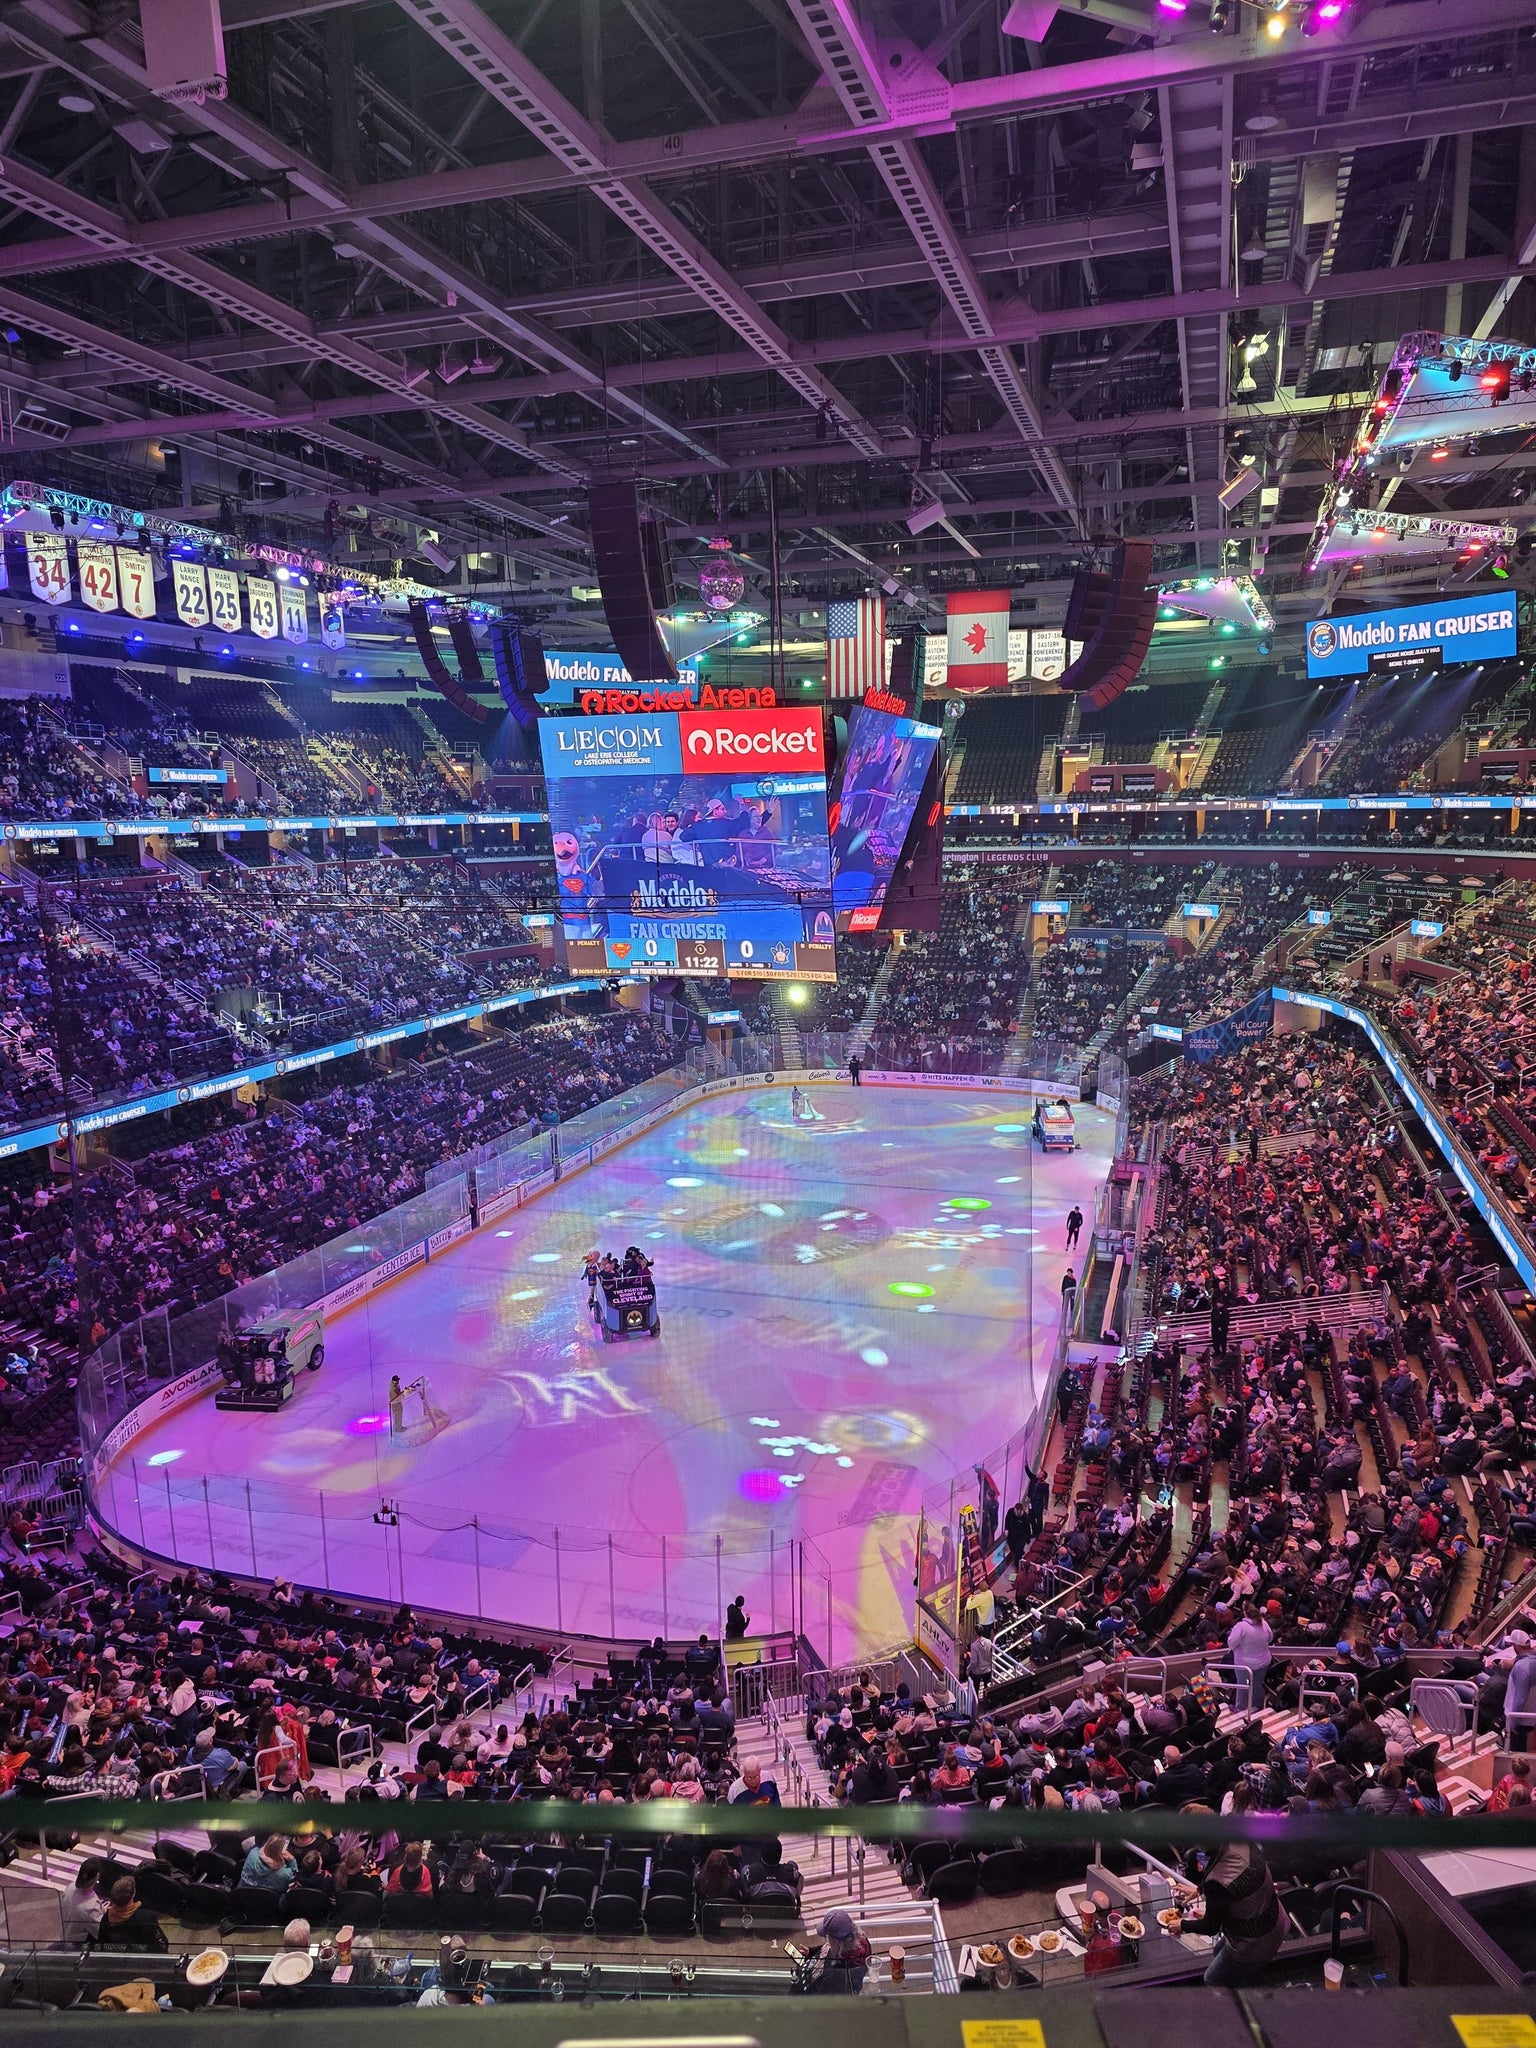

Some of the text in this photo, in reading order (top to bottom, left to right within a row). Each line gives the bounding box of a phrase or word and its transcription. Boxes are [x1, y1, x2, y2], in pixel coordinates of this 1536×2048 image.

[34, 555, 66, 590] 34
[125, 562, 146, 572] SMITH
[179, 566, 199, 577] LARRY
[85, 565, 113, 599] 42
[180, 574, 200, 584] NANCE
[214, 572, 231, 582] MARK
[130, 573, 142, 603] 7
[215, 580, 232, 590] PRICE
[254, 581, 269, 590] BRAD
[179, 584, 205, 615] 22
[214, 591, 238, 620] 25
[253, 599, 274, 628] 43
[286, 607, 304, 634] 11
[1339, 610, 1514, 649] Modelo FAN CRUISER
[1037, 632, 1061, 640] 2017-18
[1034, 648, 1064, 656] CONFERENCE
[1034, 655, 1063, 663] CHAMPIONS
[545, 658, 600, 681] Modelo
[603, 667, 633, 683] FAN
[1042, 665, 1056, 677] C
[930, 670, 942, 683] C
[606, 686, 695, 713] Rocket
[700, 684, 776, 709] Arena
[715, 726, 818, 755] Rocket
[584, 750, 639, 760] LAKE ERIE COLLEGE
[583, 757, 622, 766] OSTEOPATHIC
[623, 756, 652, 765] MEDICINE
[169, 771, 188, 781] Modelo
[989, 806, 1015, 814] 11:22
[1146, 803, 1151, 811] 7
[18, 827, 42, 837] Modelo
[942, 853, 979, 864] urlington
[1027, 853, 1049, 861] CLUB
[638, 879, 707, 908] Modelo
[630, 923, 727, 940] FAN CRUISER
[645, 939, 658, 956] 0
[740, 940, 754, 958] 0
[685, 956, 719, 968] 11:22
[1230, 1020, 1269, 1030] Full Court
[1236, 1028, 1262, 1037] Power
[982, 1078, 1002, 1087] WM
[76, 1116, 104, 1133] Modelo
[382, 1252, 409, 1275] CENTER
[410, 1245, 421, 1259] ICE
[612, 1294, 653, 1304] CLEVELAND
[771, 1938, 778, 1949] 1
